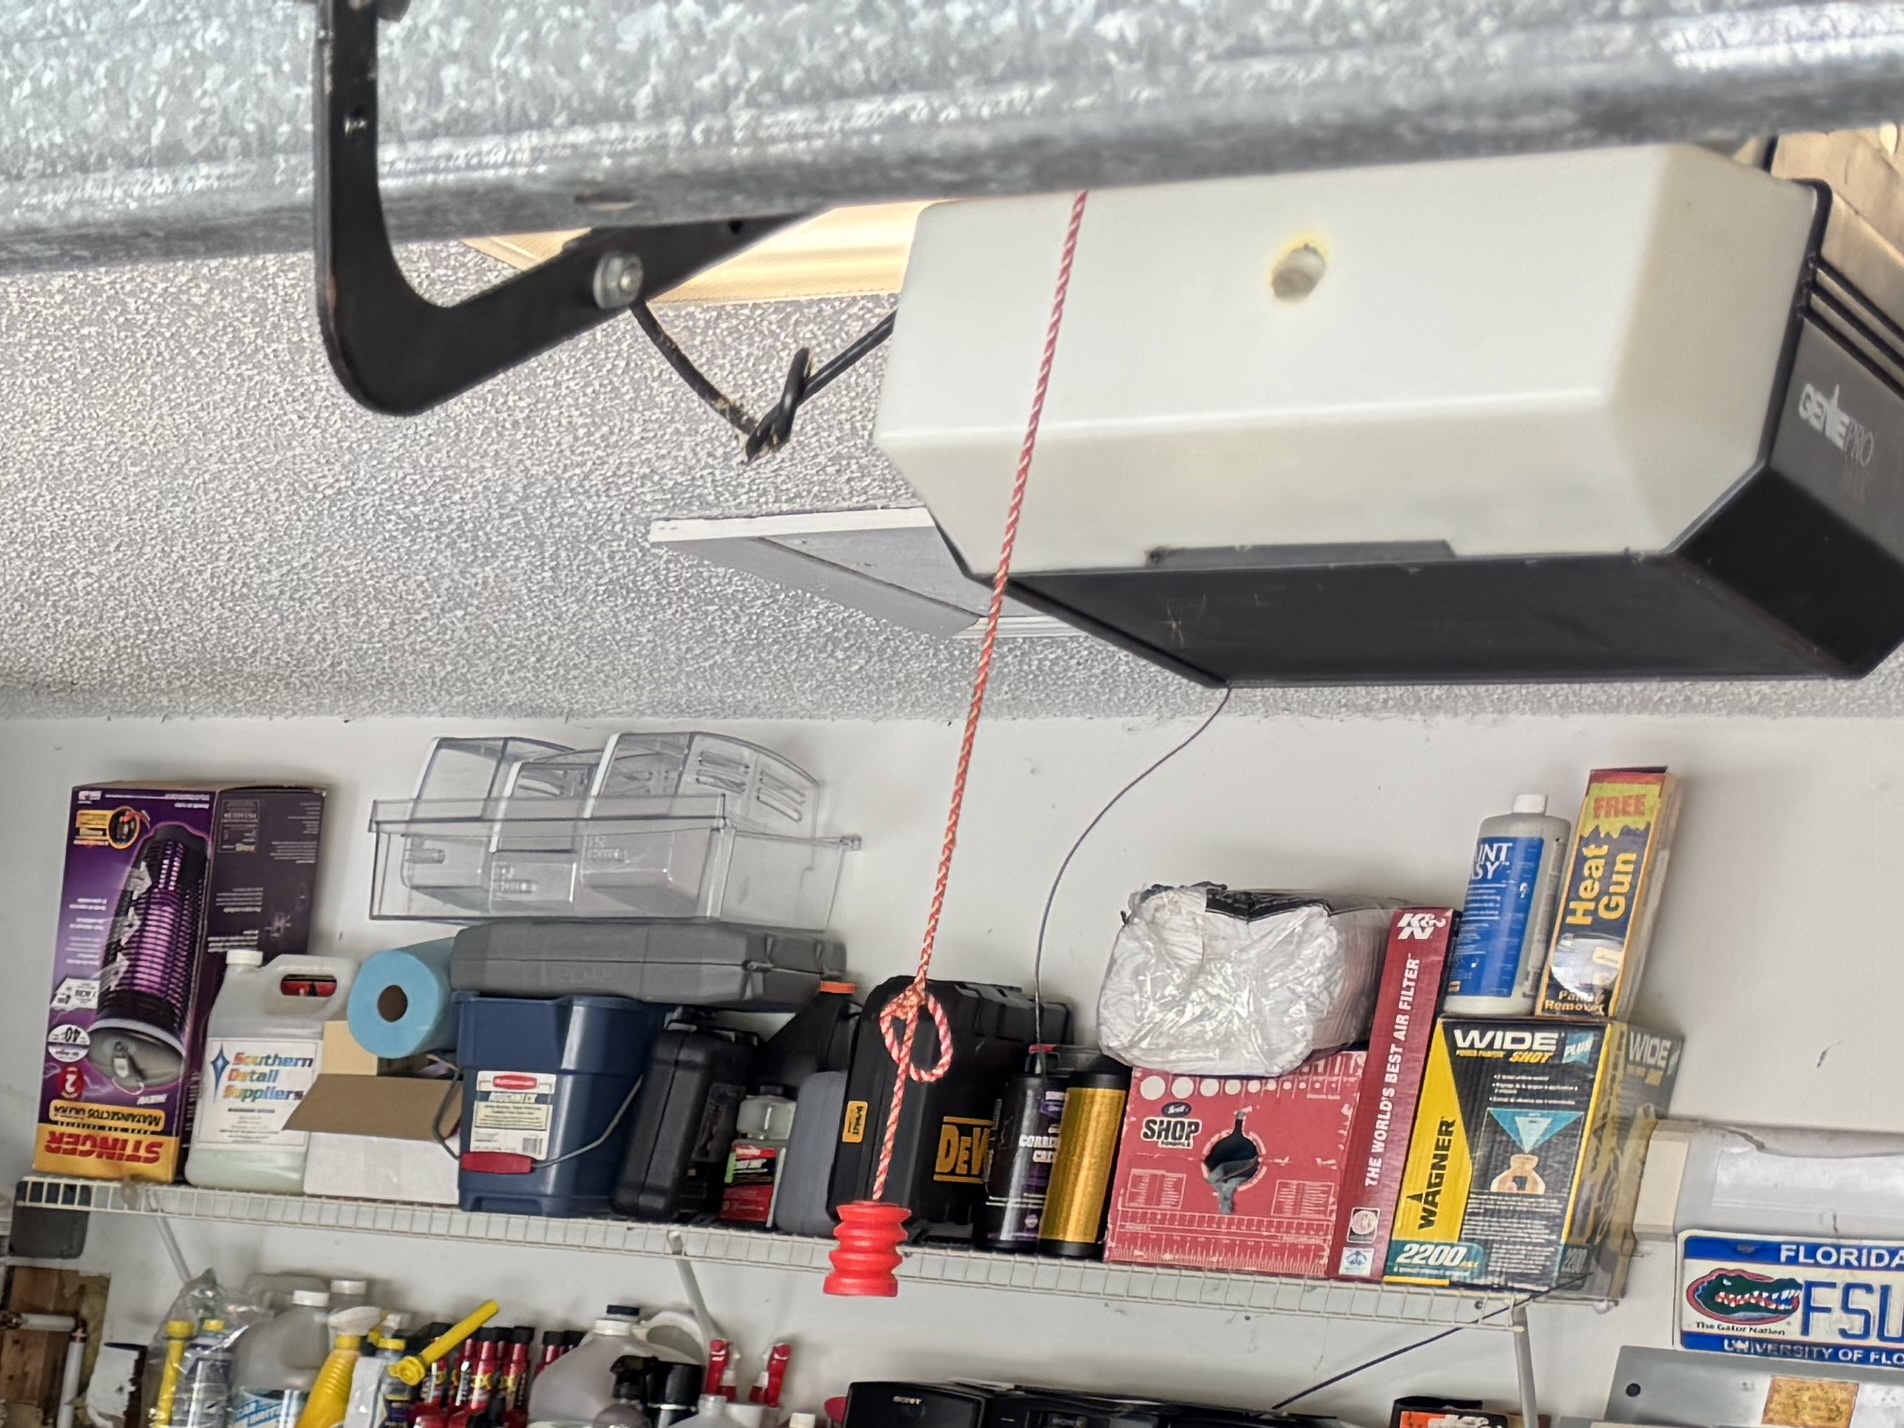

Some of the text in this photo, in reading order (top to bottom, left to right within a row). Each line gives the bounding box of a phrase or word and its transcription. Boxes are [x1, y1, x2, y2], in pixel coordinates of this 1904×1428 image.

[1594, 794, 1646, 820] FREE
[1566, 844, 1609, 925] Heat
[1598, 852, 1637, 920] Gun
[1397, 913, 1446, 940] K&N
[1453, 1029, 1559, 1052] WIDE
[1564, 1037, 1594, 1057] PLUS
[233, 1052, 314, 1068] Southern
[1511, 1051, 1553, 1064] SHOT
[228, 1068, 279, 1084] Detail
[1364, 953, 1421, 1187] THE WORLD'S BEST AIR FILTER
[223, 1086, 304, 1103] Suppliers
[1143, 1119, 1201, 1140] SHOP
[44, 1131, 165, 1165] STINGER
[1406, 1119, 1456, 1230] WAGNER
[1397, 1243, 1468, 1267] 2200
[1780, 1244, 1904, 1267] FLORIDA
[1696, 1321, 1786, 1336] The Gator Nation
[1723, 1338, 1833, 1360] UNIVERSITY
[1838, 1348, 1864, 1361] OF
